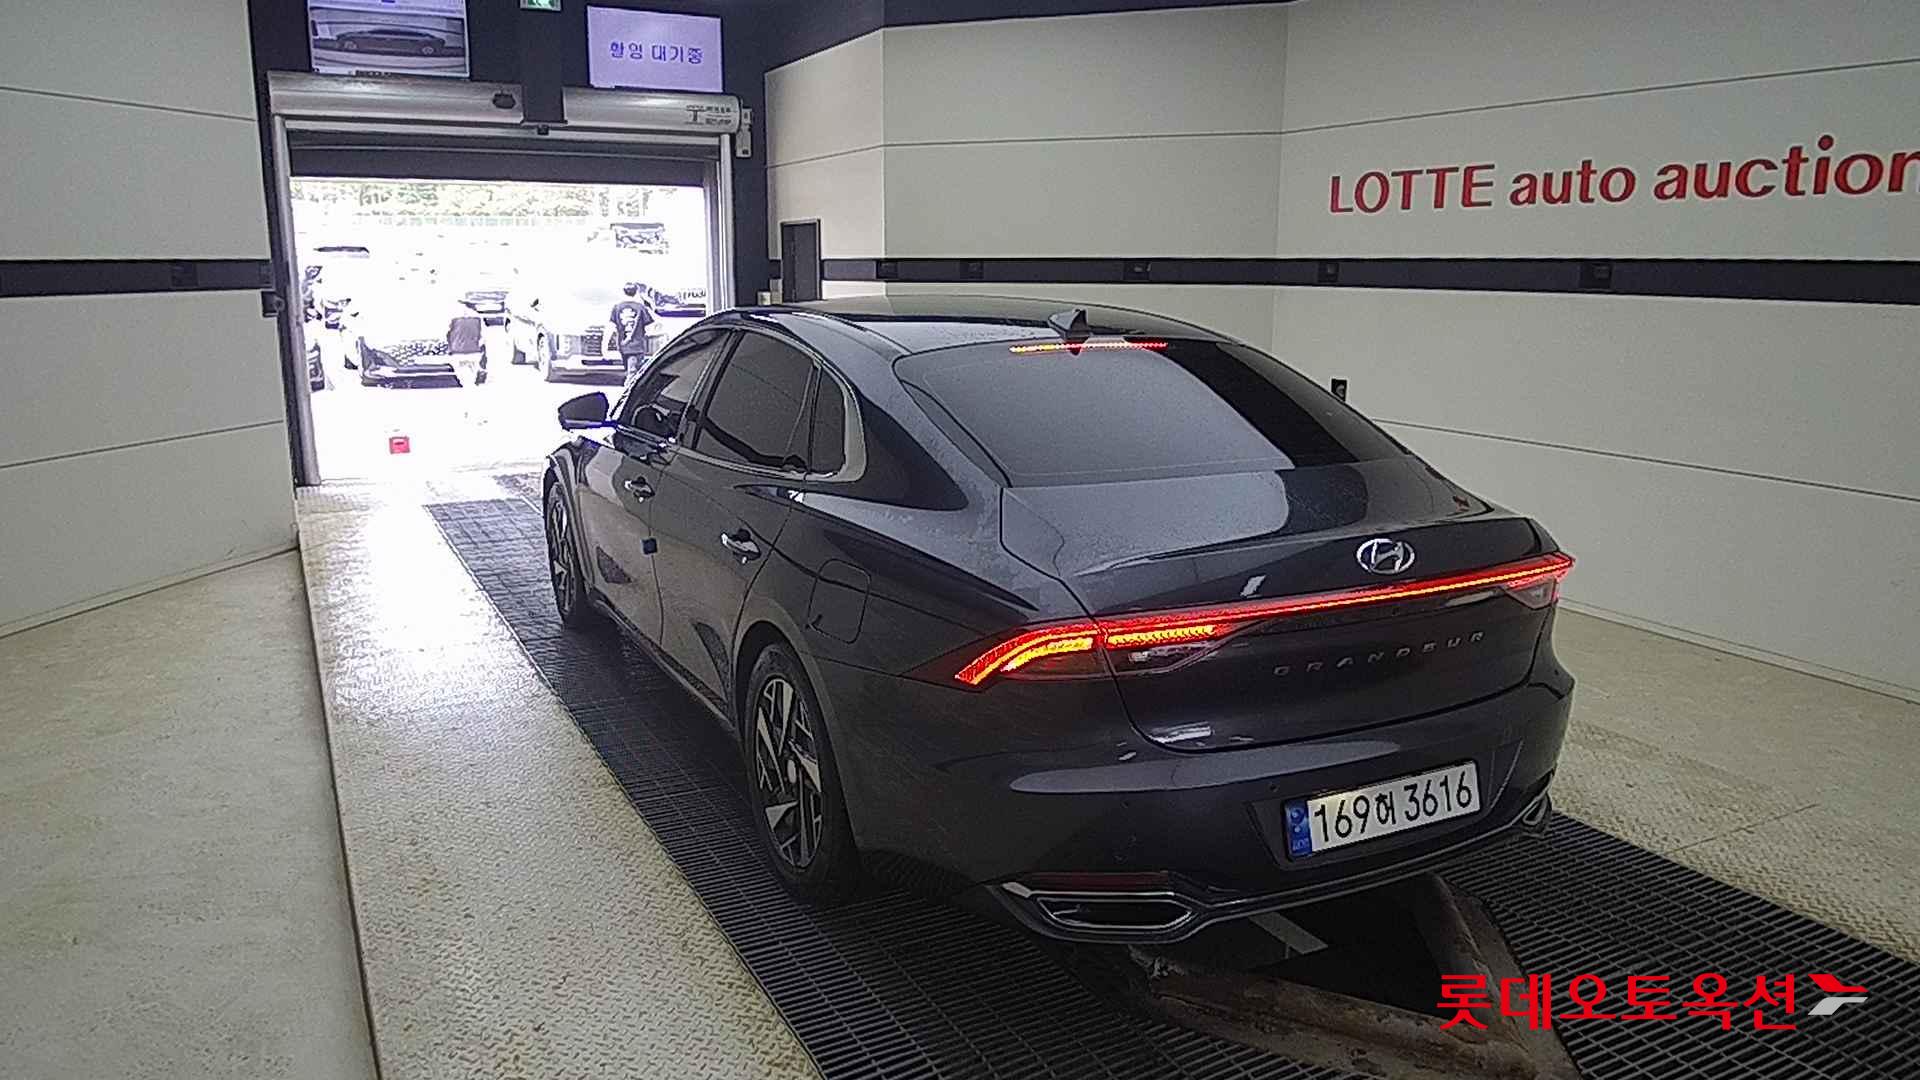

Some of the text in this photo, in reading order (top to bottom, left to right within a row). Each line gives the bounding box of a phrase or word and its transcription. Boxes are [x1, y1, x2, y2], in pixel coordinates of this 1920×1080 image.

[652, 44, 702, 64] 대기중
[1330, 163, 1495, 214] LOTTE
[1509, 160, 1636, 206] auto
[1273, 631, 1484, 676] GRANDEUR
